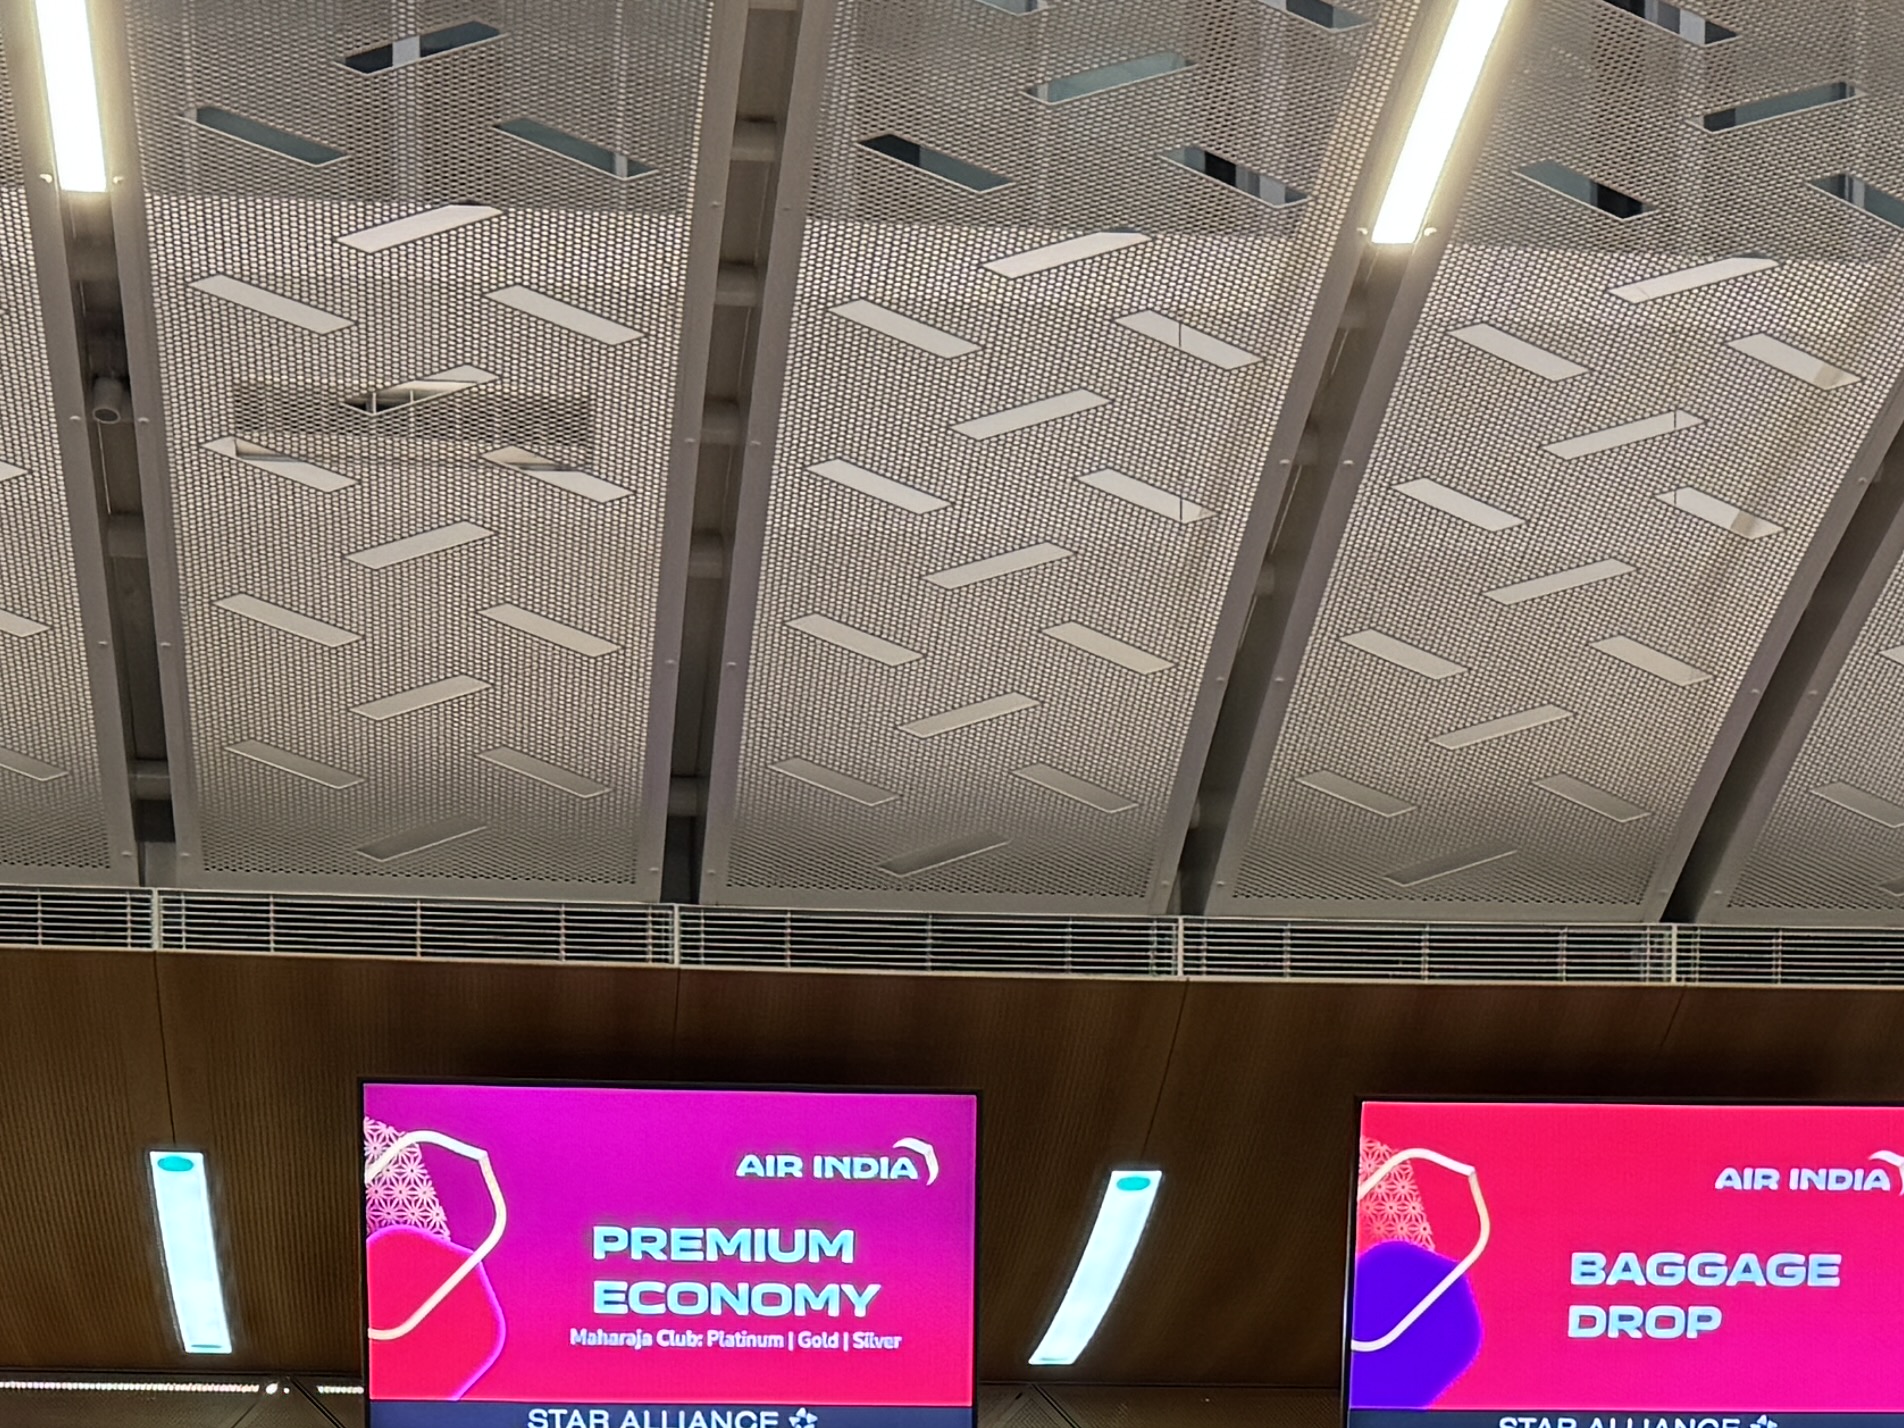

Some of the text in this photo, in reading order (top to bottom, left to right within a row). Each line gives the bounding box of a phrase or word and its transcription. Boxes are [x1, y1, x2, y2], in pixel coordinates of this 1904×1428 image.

[735, 1154, 920, 1180] AIR INDIA
[1714, 1167, 1892, 1192] AIR INDIA
[592, 1226, 855, 1264] PREMIUM
[1570, 1251, 1843, 1287] BAGGAGE
[593, 1280, 882, 1318] ECONOMY
[1567, 1305, 1723, 1339] DROP
[569, 1328, 902, 1351] Maharaja Club: Platinum Gold Silver
